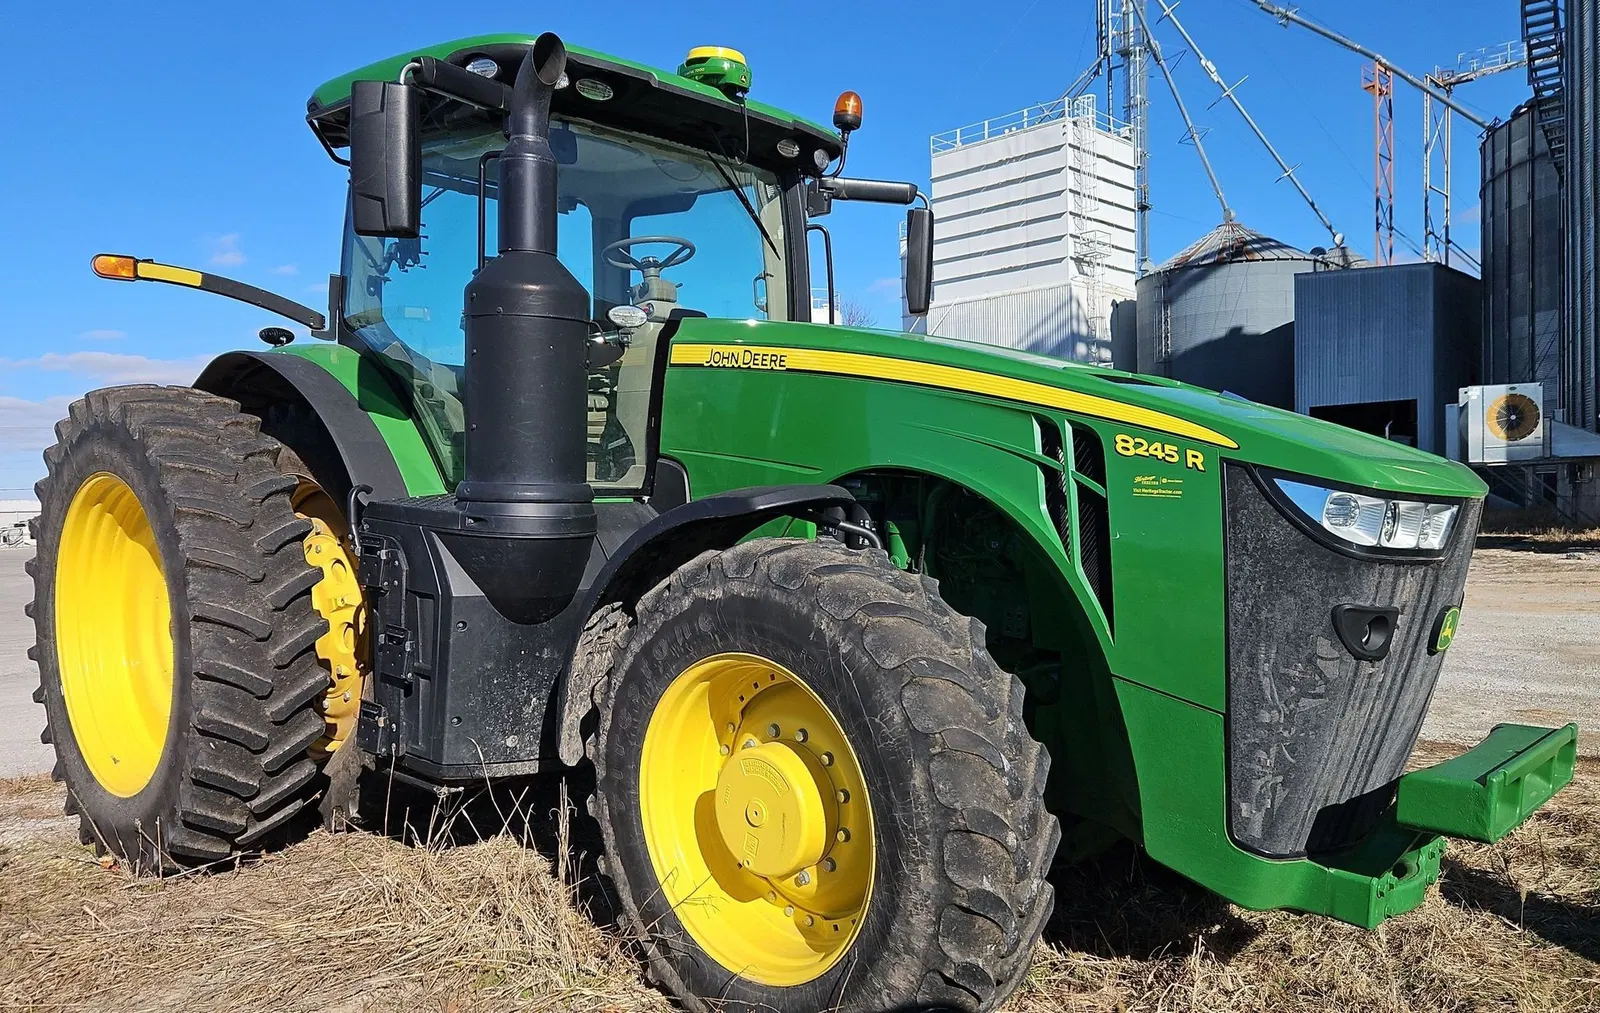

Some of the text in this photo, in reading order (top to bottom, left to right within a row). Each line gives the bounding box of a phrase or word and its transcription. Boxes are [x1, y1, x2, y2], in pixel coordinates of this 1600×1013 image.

[705, 348, 788, 368] JOHN DEERE
[1114, 433, 1206, 472] 8245 R
